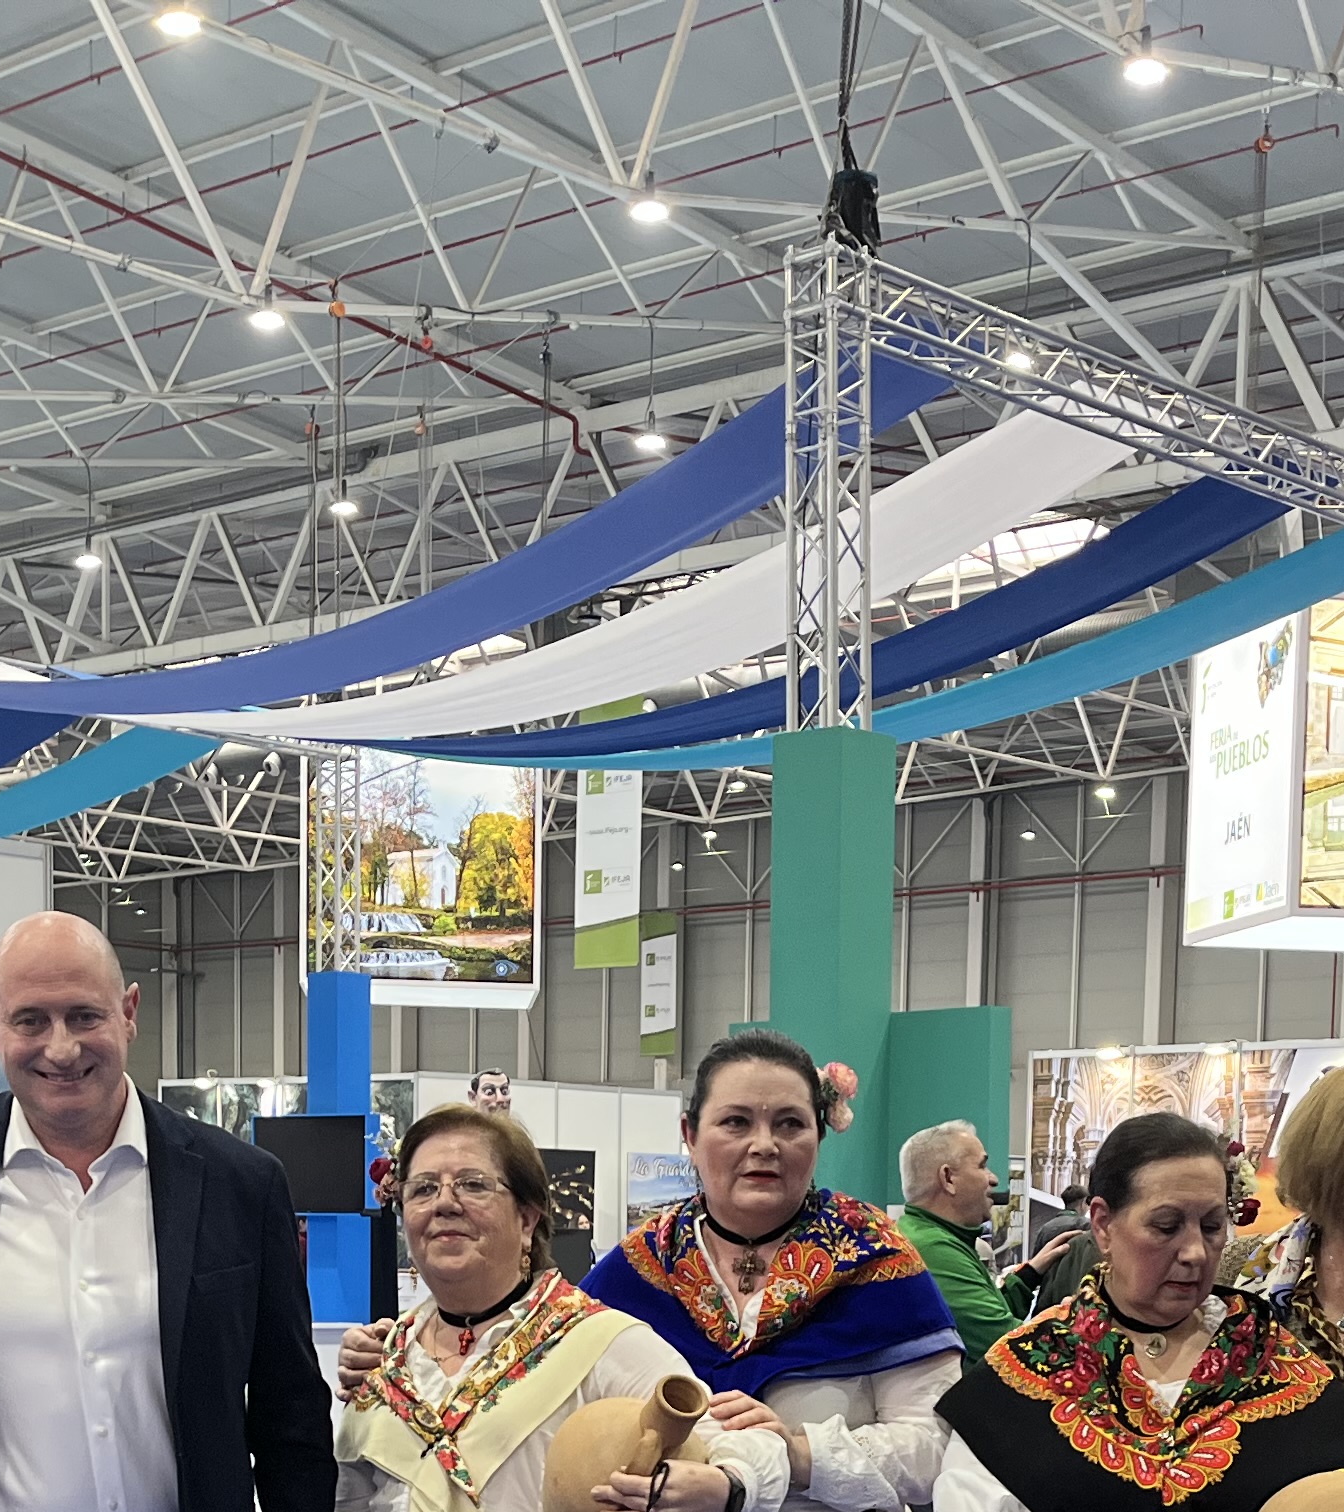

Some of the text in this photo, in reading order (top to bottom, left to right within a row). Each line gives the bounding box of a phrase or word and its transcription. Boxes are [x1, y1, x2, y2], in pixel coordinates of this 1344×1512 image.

[1210, 724, 1233, 751] FERIA
[1216, 730, 1270, 779] PUEBLOS
[1224, 812, 1252, 845] JAÉN
